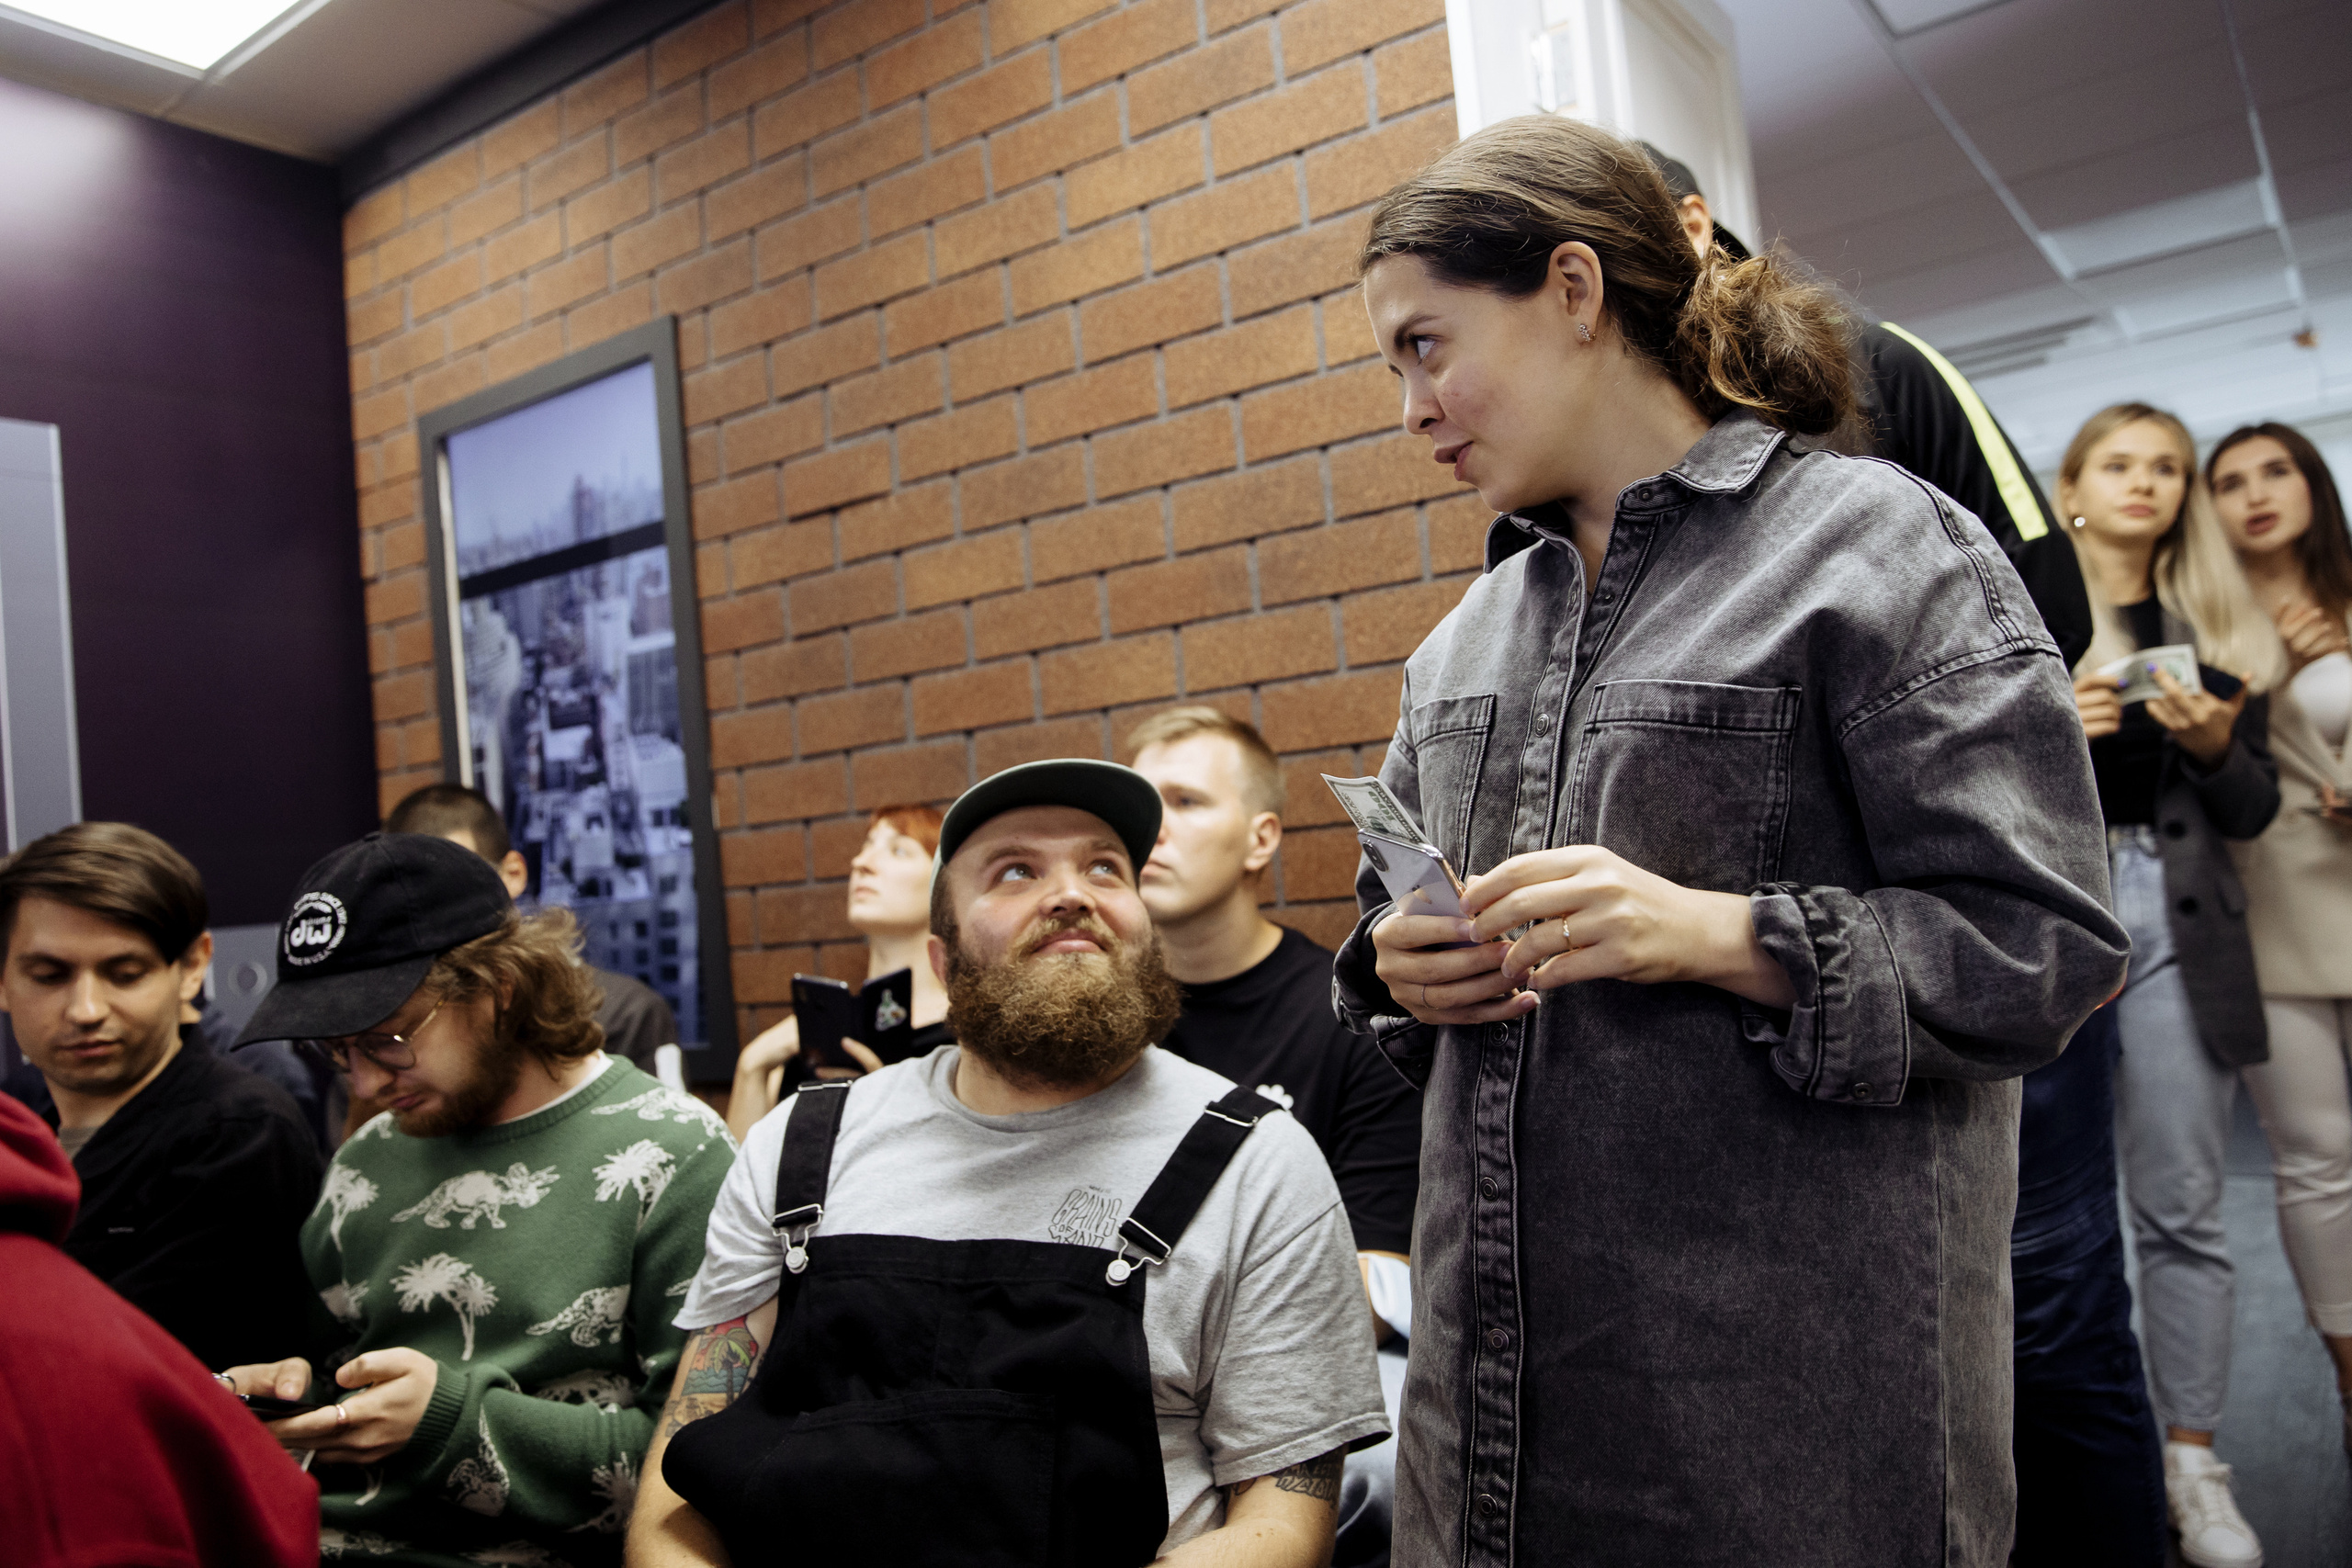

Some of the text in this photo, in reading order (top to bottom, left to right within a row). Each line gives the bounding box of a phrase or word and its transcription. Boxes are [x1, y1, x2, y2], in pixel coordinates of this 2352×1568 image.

[1368, 791, 1396, 820] 100
[1051, 1188, 1123, 1237] GRAINS
[1058, 1224, 1074, 1233] OF
